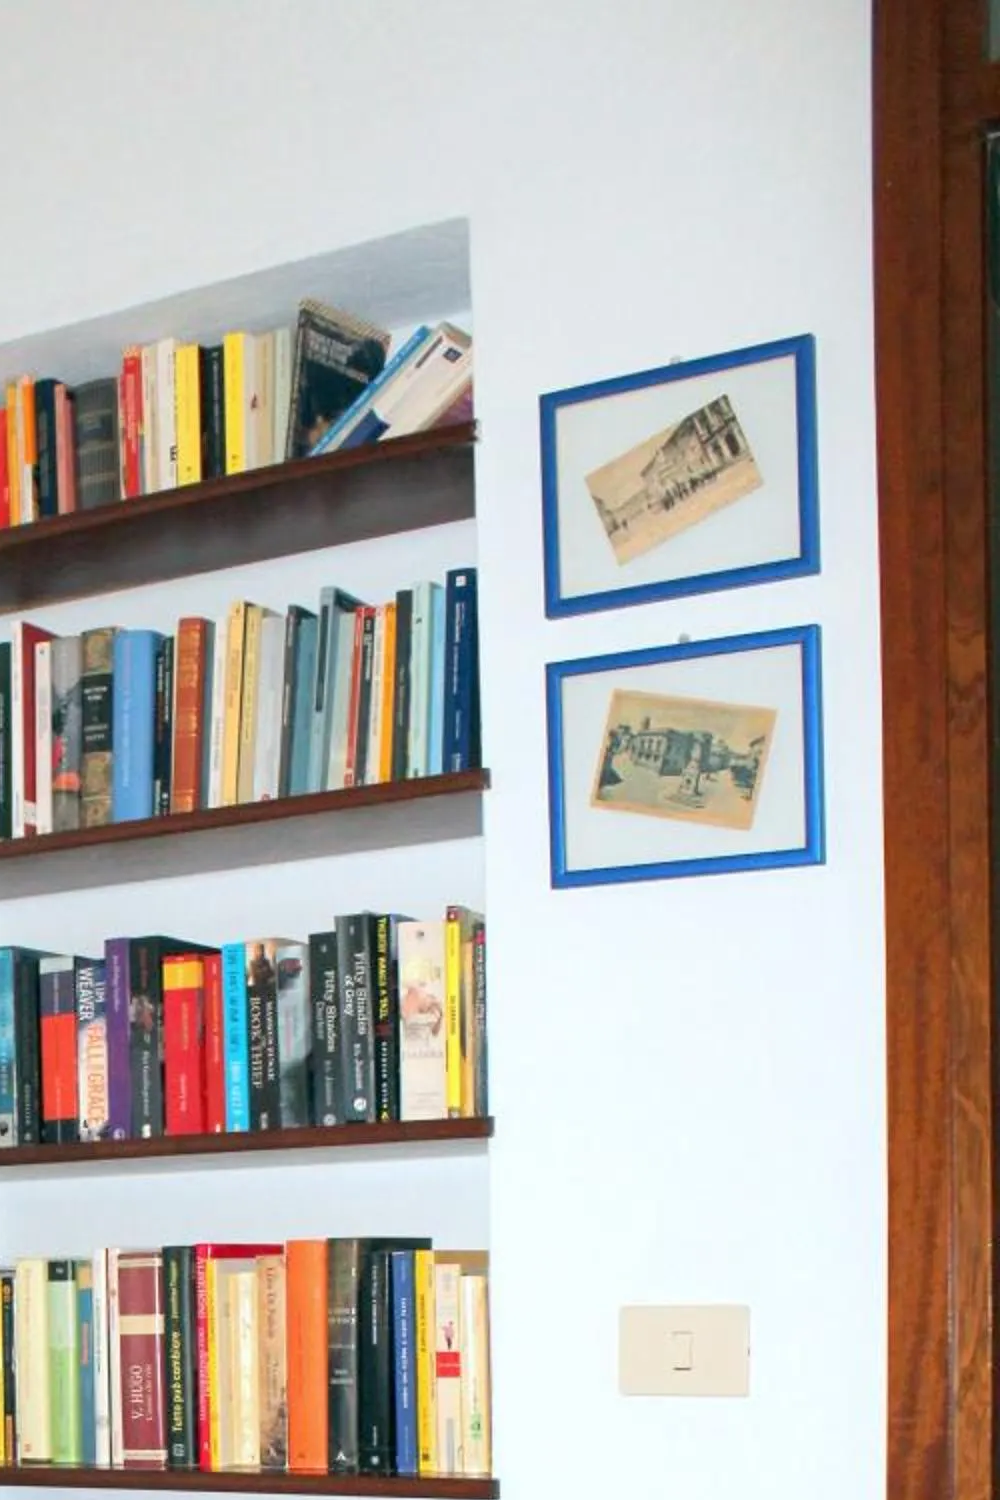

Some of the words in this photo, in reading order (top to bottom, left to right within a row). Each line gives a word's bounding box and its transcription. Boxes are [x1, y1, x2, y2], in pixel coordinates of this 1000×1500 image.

[324, 971, 335, 1002] Fifty
[354, 952, 366, 984] Fifty
[79, 968, 94, 1020] WEAVER
[95, 982, 105, 1002] TIM
[344, 990, 355, 1016] Grey
[250, 997, 261, 1039] BOOK
[327, 1005, 336, 1052] Shades
[356, 988, 367, 1035] Shades
[87, 1025, 103, 1058] FALL
[88, 1073, 105, 1122] GRACE
[130, 1365, 144, 1403] HUGO
